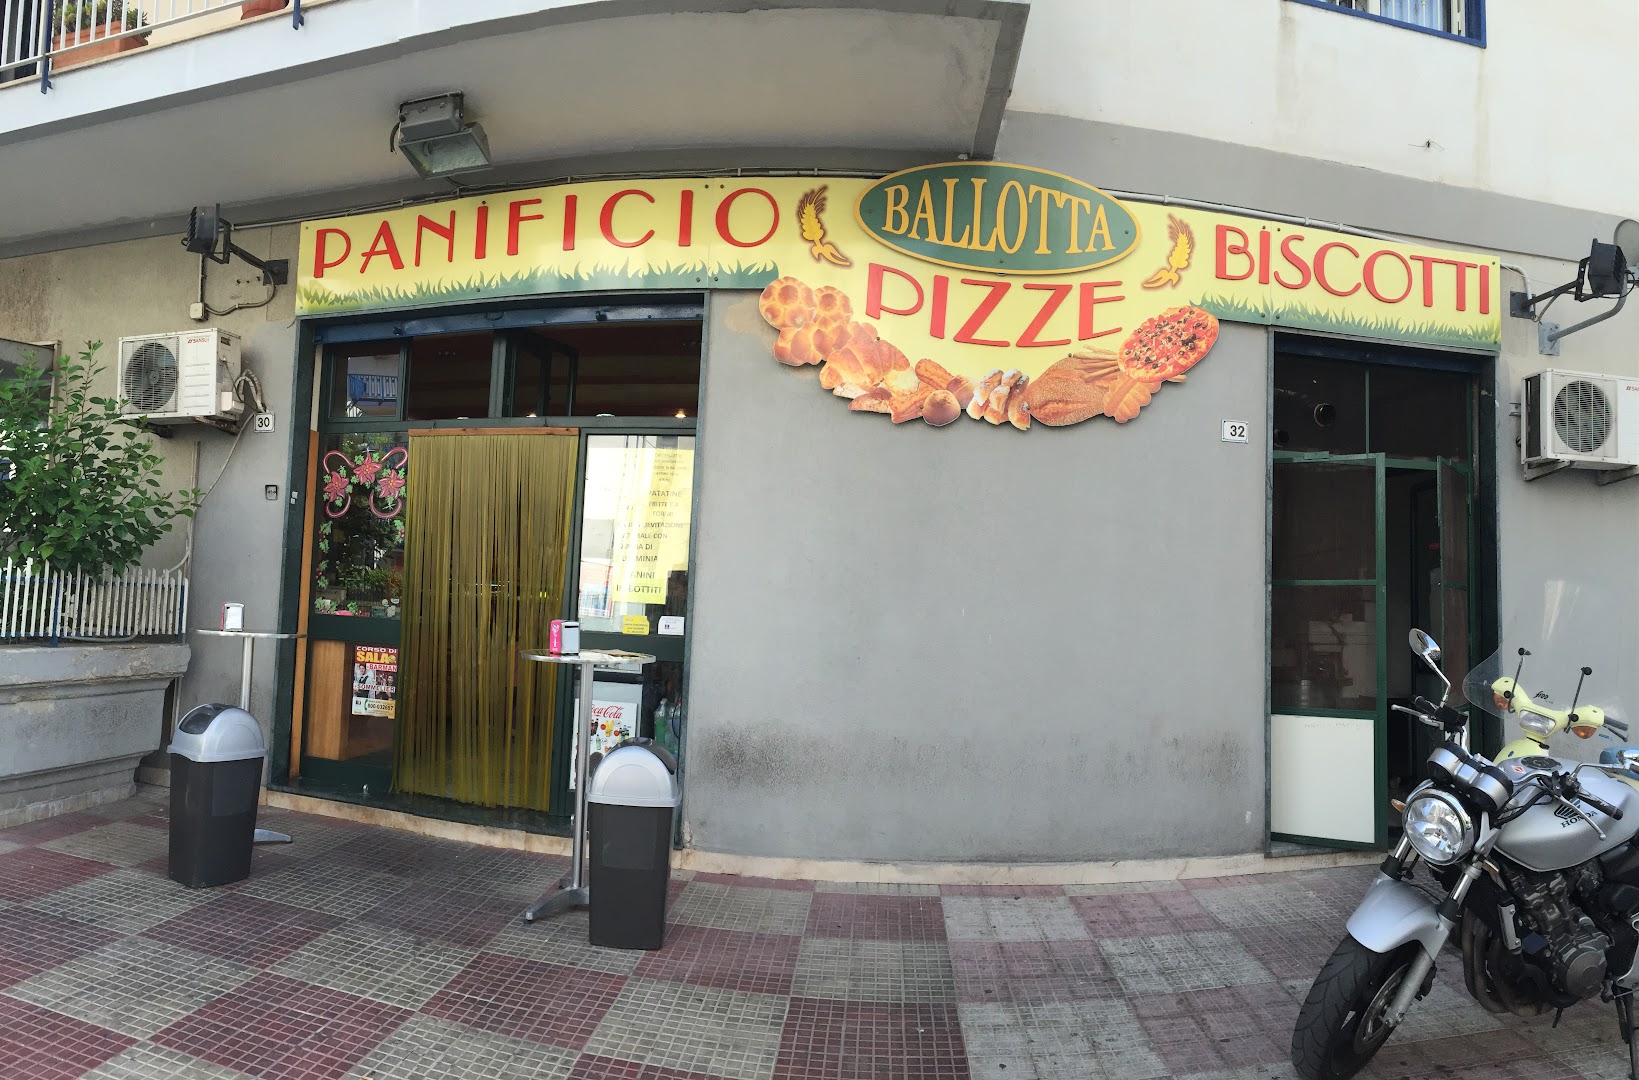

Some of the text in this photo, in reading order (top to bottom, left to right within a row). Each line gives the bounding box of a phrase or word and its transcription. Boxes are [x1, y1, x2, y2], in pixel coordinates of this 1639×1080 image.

[313, 188, 780, 278] PANIFICIO
[881, 177, 1116, 255] BALLOTTA
[1215, 224, 1490, 314] BISCOTTI
[866, 262, 1126, 348] PIZZE
[257, 416, 270, 428] 30
[1229, 424, 1245, 438] 32
[653, 532, 668, 540] CON
[356, 651, 389, 664] SALA
